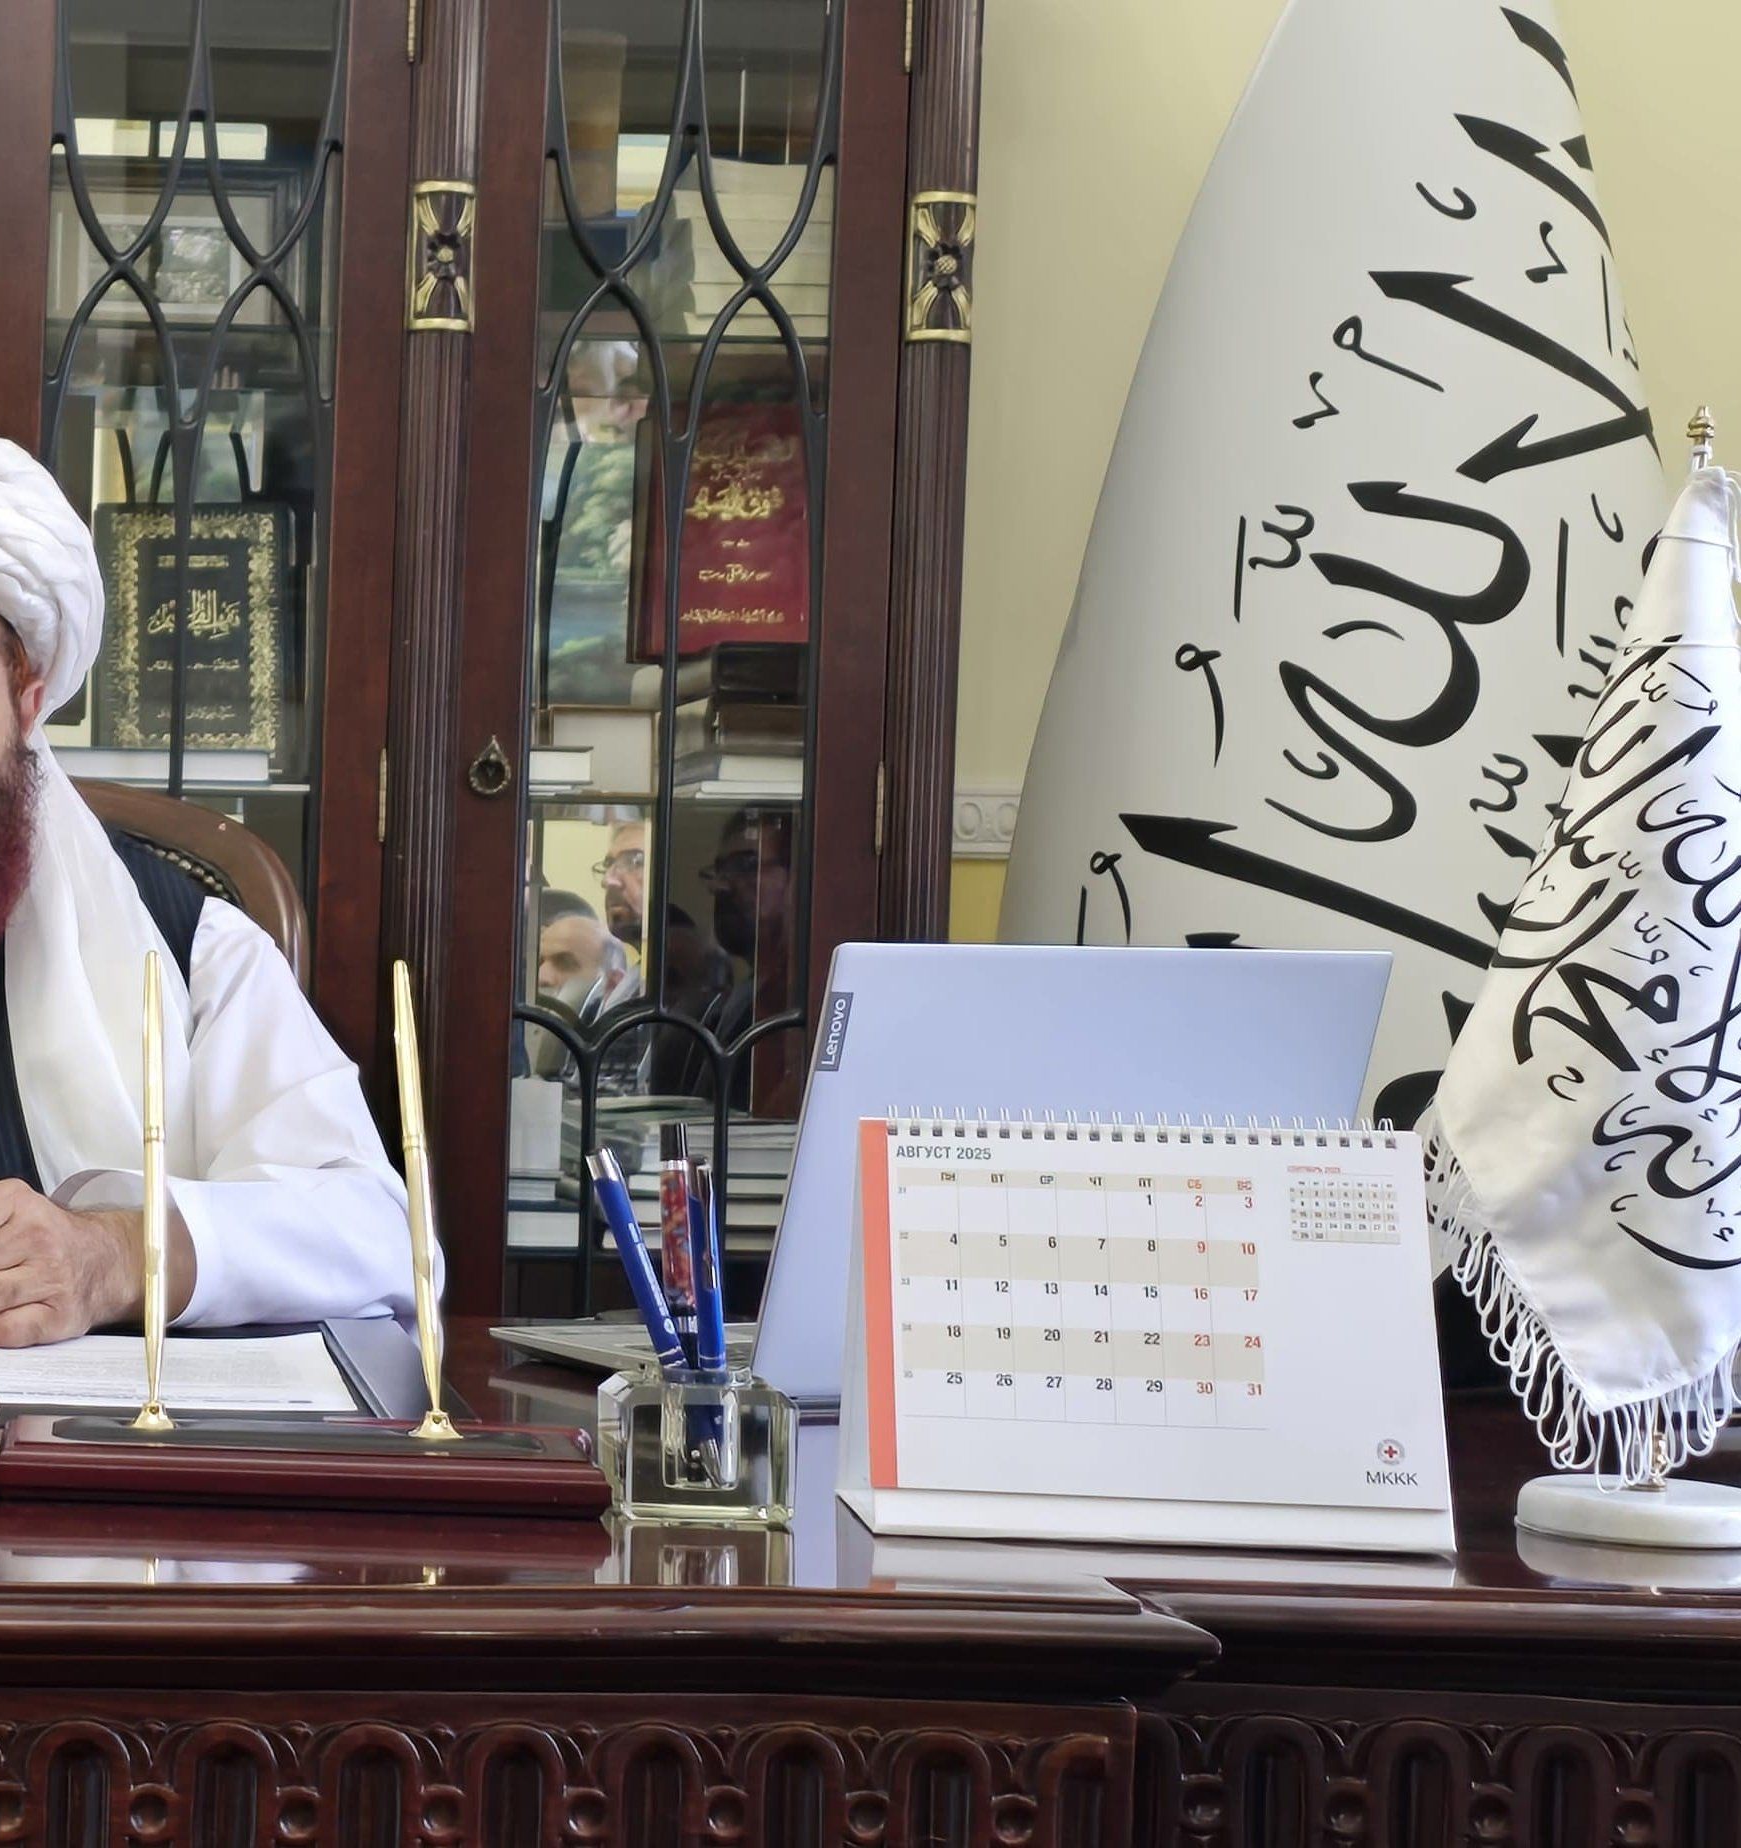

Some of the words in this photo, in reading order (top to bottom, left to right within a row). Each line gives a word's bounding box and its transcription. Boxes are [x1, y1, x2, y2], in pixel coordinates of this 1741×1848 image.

[821, 999, 846, 1065] Lenovo
[896, 1145, 951, 1160] АВГУСТ
[957, 1147, 992, 1160] 2025
[941, 1172, 955, 1182] ПН
[991, 1174, 1004, 1184] ВТ
[1040, 1176, 1054, 1185] СР
[1090, 1177, 1102, 1186] ЧТ
[1139, 1178, 1152, 1188] ПТ
[1188, 1179, 1202, 1189] СБ
[1237, 1180, 1252, 1191] ВС
[1147, 1194, 1152, 1205] 1
[1195, 1196, 1203, 1207] 2
[1245, 1197, 1253, 1208] 3
[950, 1233, 958, 1245] 4
[999, 1235, 1008, 1247] 5
[1048, 1237, 1057, 1248] 6
[1098, 1239, 1106, 1250] 7
[1148, 1240, 1156, 1252] 8
[1197, 1242, 1205, 1253] 9
[1242, 1243, 1256, 1255] 10
[946, 1280, 958, 1291] 11
[995, 1281, 1009, 1293] 12
[1045, 1283, 1058, 1294] 13
[1094, 1285, 1108, 1296] 14
[1144, 1286, 1158, 1298] 15
[1194, 1288, 1208, 1300] 16
[1244, 1289, 1258, 1301] 17
[947, 1326, 961, 1338] 18
[997, 1328, 1011, 1339] 19
[1044, 1329, 1060, 1341] 20
[1094, 1331, 1109, 1343] 21
[1144, 1333, 1160, 1345] 22
[1194, 1334, 1210, 1346] 23
[1244, 1336, 1261, 1348] 24
[946, 1372, 962, 1384] 25
[996, 1374, 1013, 1386] 26
[1046, 1377, 1062, 1388] 27
[1096, 1379, 1112, 1390] 28
[1146, 1380, 1163, 1392] 29
[1197, 1382, 1213, 1394] 30
[1248, 1384, 1262, 1395] 31
[1366, 1471, 1418, 1486] МККК
